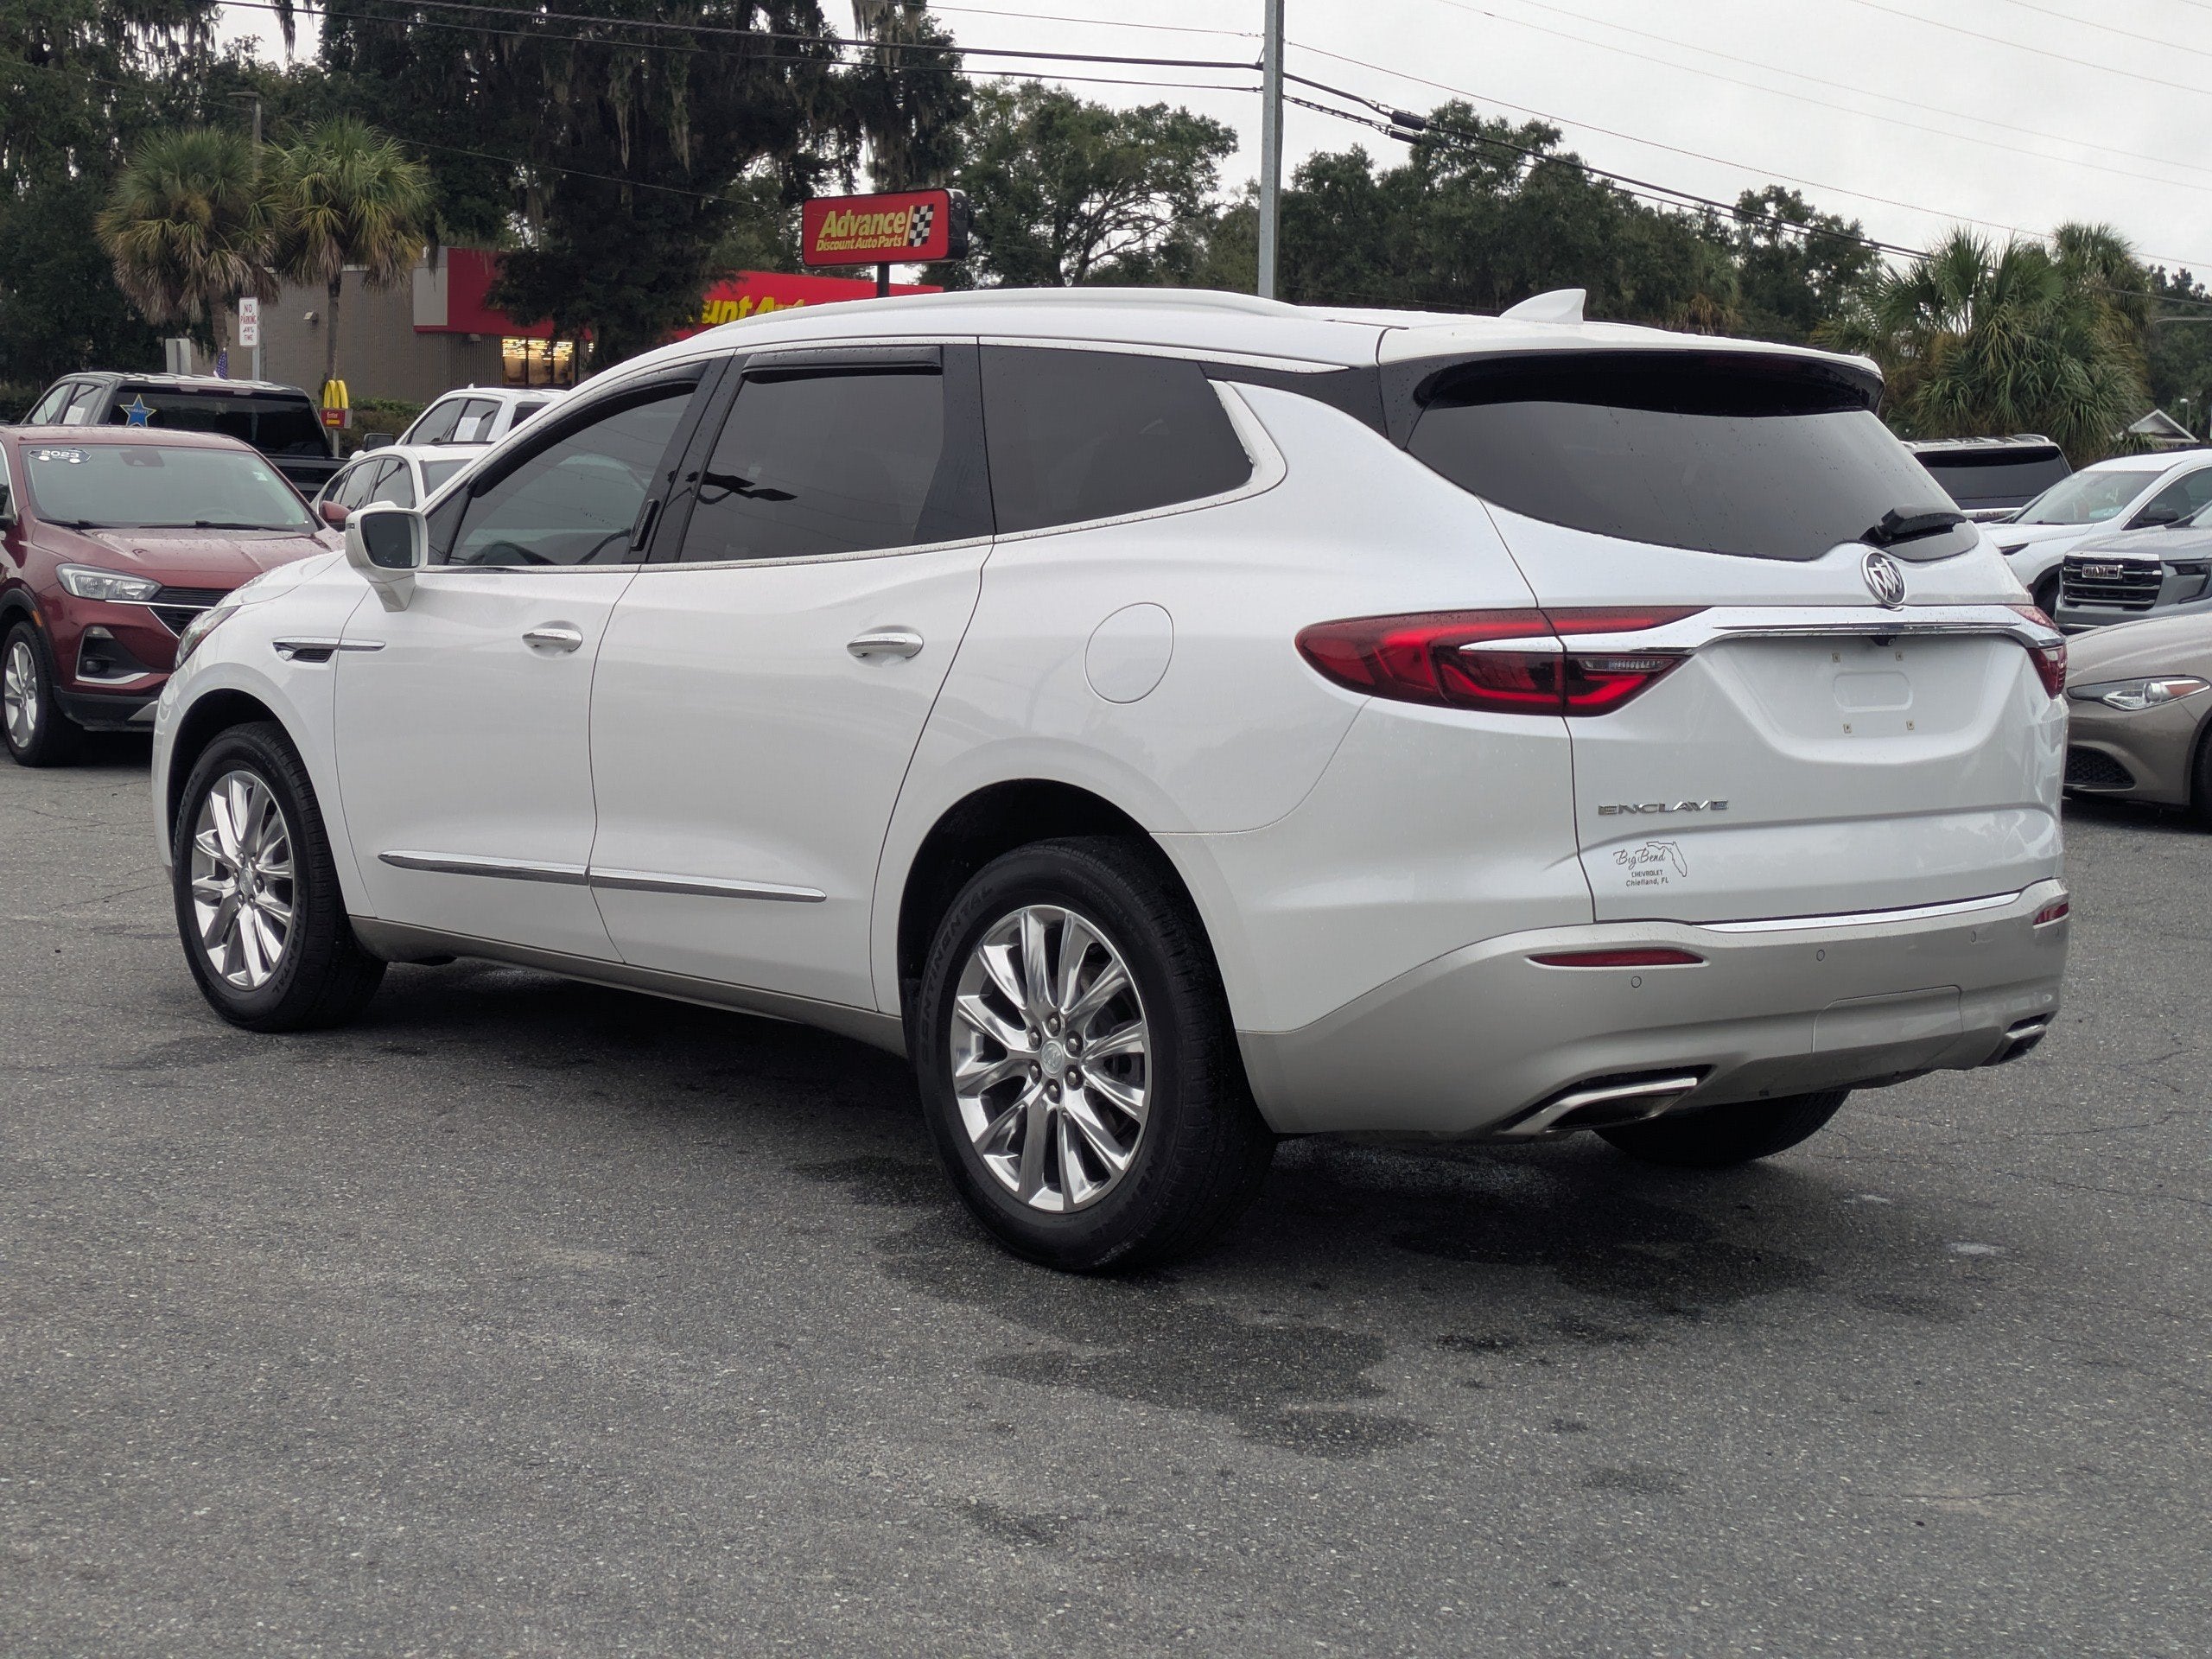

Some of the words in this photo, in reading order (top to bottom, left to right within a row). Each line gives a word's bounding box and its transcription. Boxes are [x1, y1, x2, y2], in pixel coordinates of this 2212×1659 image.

[818, 208, 906, 238] Advance
[816, 237, 855, 251] Discount
[855, 237, 878, 250] Auto
[878, 235, 903, 248] Parts
[244, 303, 253, 313] NO
[41, 448, 79, 459] 2023
[2082, 564, 2121, 580] GMC
[1598, 799, 1729, 816] ENCLAVE
[1613, 849, 1637, 871] Big
[1635, 847, 1666, 864] Bend
[1631, 869, 1663, 878] CHEVROLET
[1661, 876, 1669, 885] FL
